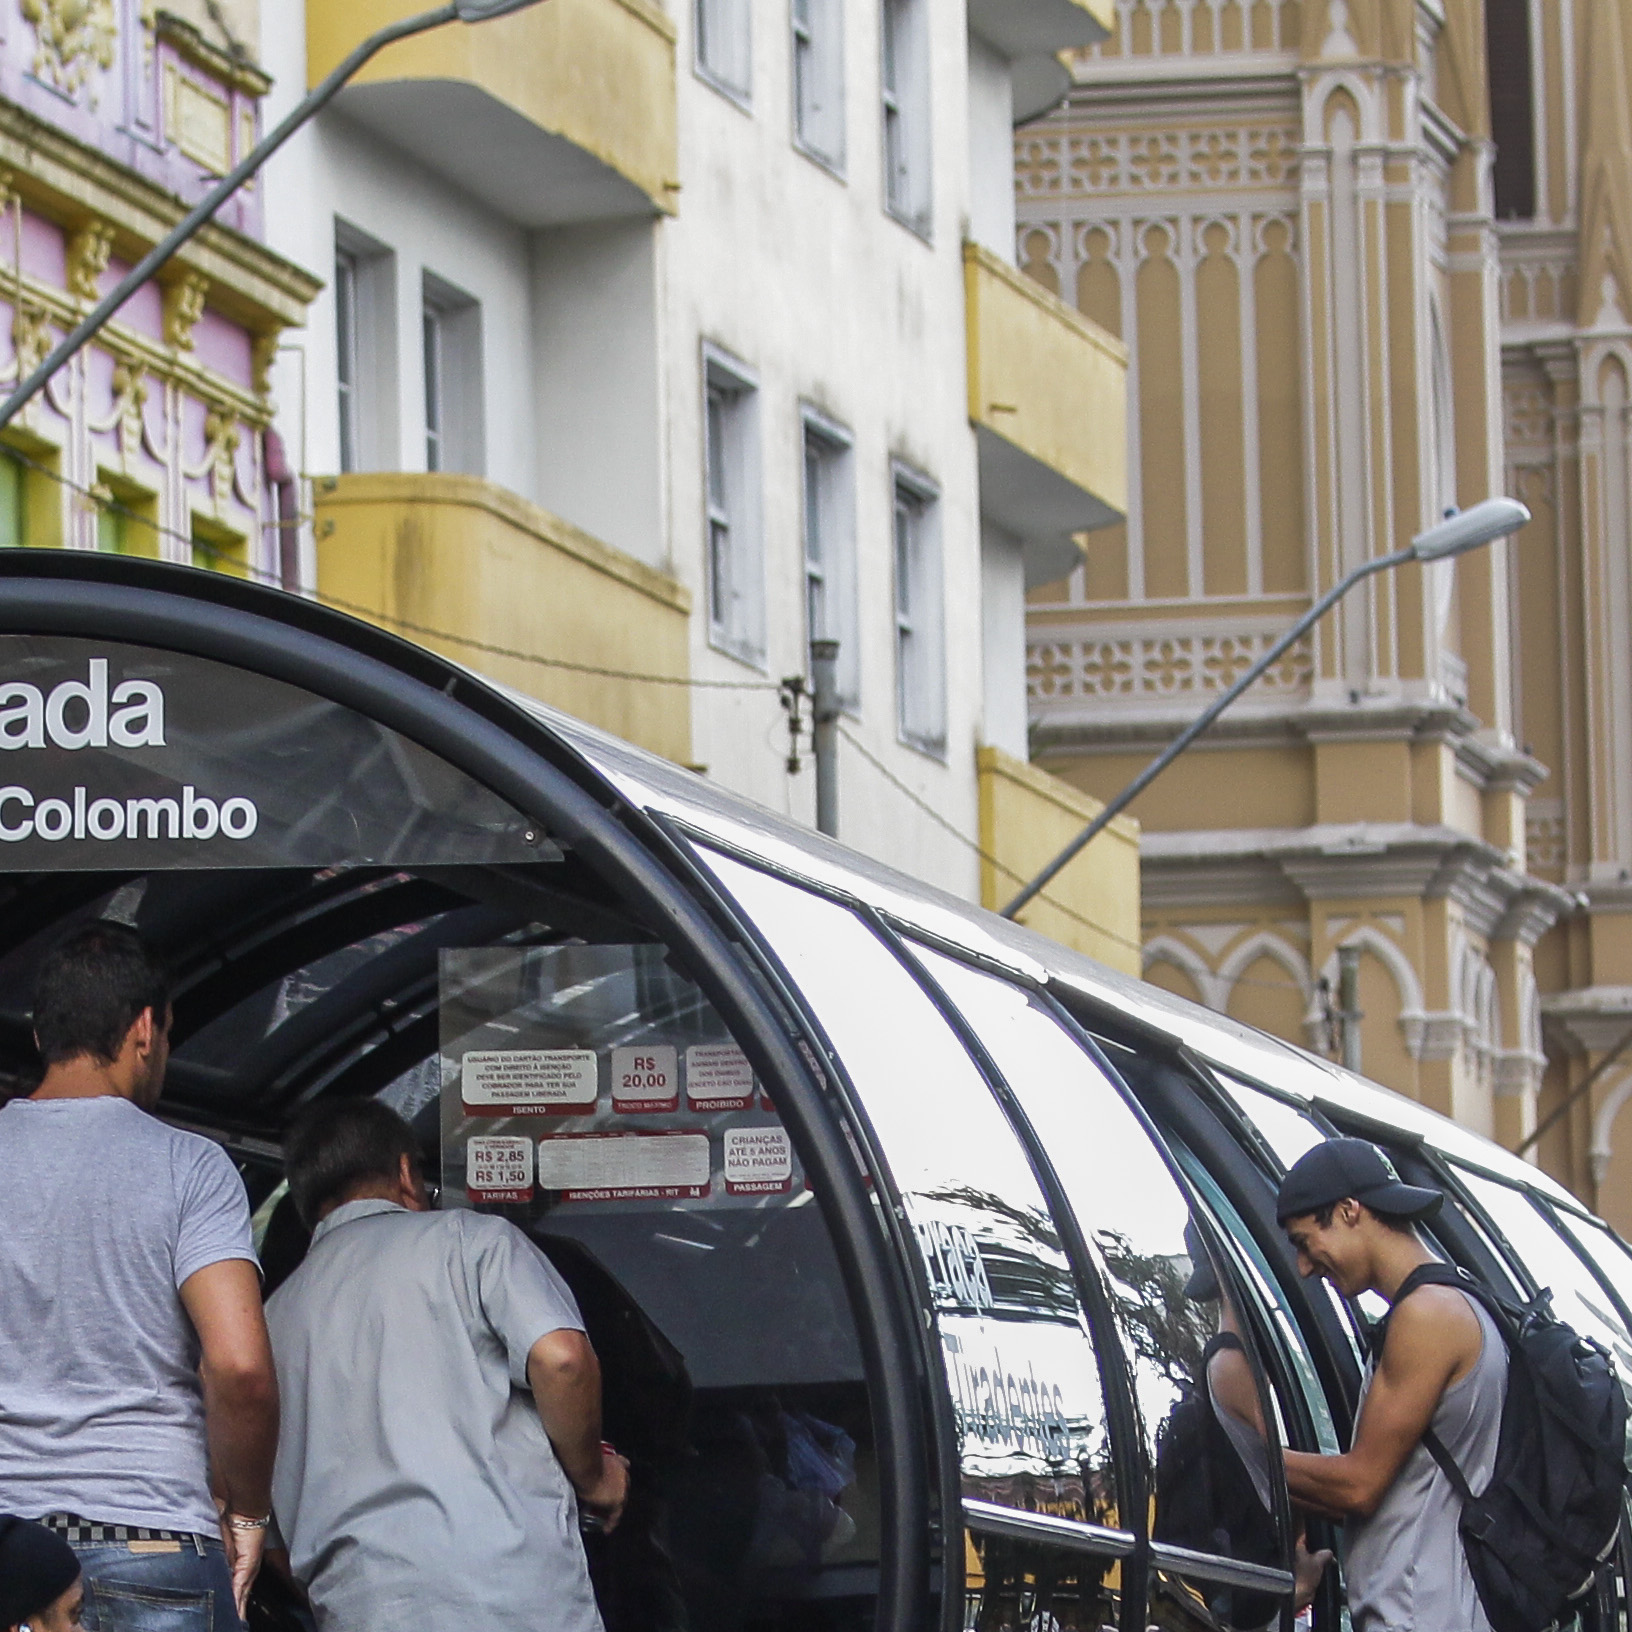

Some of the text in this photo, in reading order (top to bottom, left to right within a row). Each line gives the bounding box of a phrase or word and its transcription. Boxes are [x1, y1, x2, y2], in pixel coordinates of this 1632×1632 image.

[513, 1105, 546, 1114] ISENTO
[696, 1100, 744, 1110] PROIBIDO
[732, 1135, 783, 1145] CRIANÇAS
[758, 1145, 786, 1155] ANOS
[733, 1182, 783, 1192] PASSAGEM
[481, 1192, 518, 1200] TARIFAS
